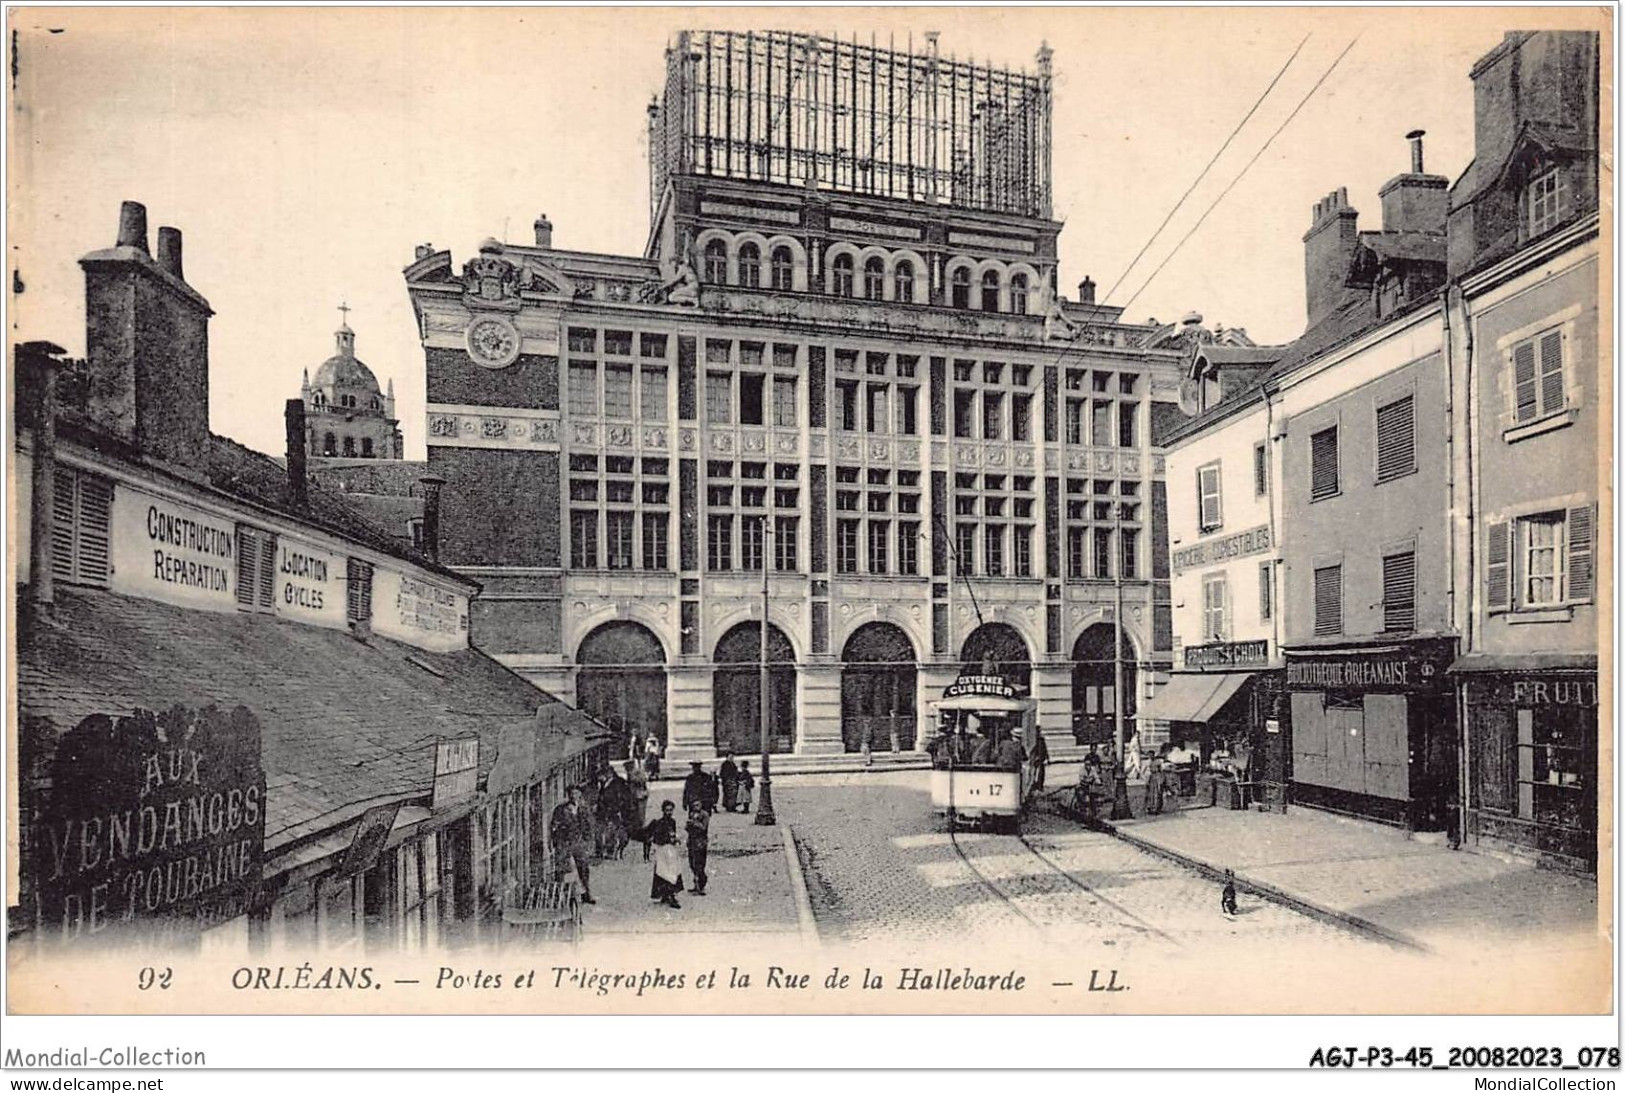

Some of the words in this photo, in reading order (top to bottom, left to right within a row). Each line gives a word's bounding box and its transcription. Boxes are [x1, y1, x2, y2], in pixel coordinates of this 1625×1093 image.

[1233, 642, 1265, 663] CHOIX
[949, 684, 1013, 697] CUSENIER
[141, 748, 203, 797] AUX
[989, 784, 1003, 796] 17
[49, 785, 259, 882] VENDANGES
